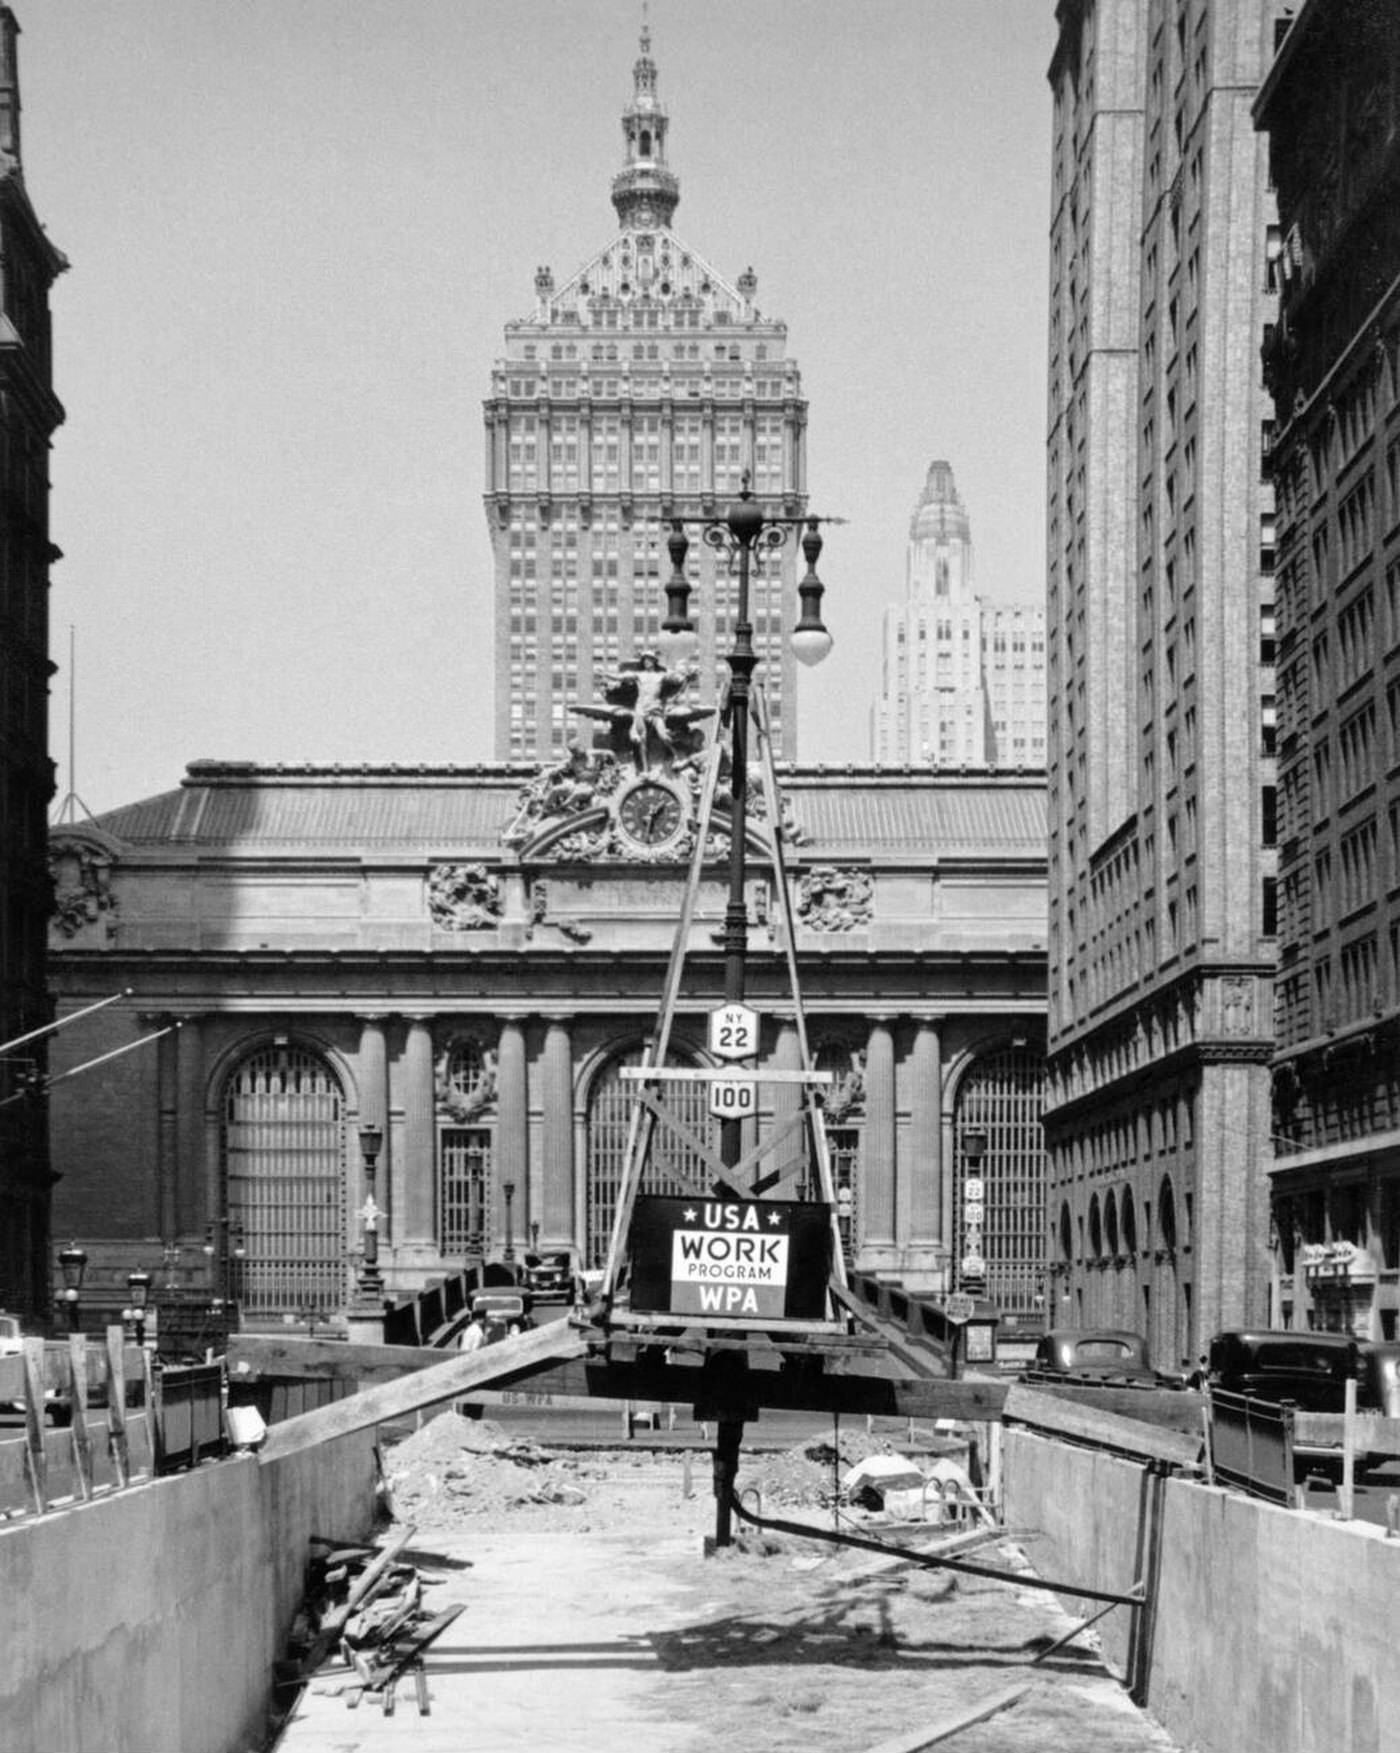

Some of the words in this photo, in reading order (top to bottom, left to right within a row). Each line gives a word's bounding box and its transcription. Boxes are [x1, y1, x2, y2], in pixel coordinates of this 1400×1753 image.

[725, 1013, 743, 1024] NY
[720, 1027, 748, 1047] 22
[715, 1087, 751, 1108] 100
[704, 1203, 760, 1231] USA
[680, 1235, 781, 1263] WORK
[688, 1263, 772, 1280] PROGRAM
[699, 1285, 759, 1313] WPA
